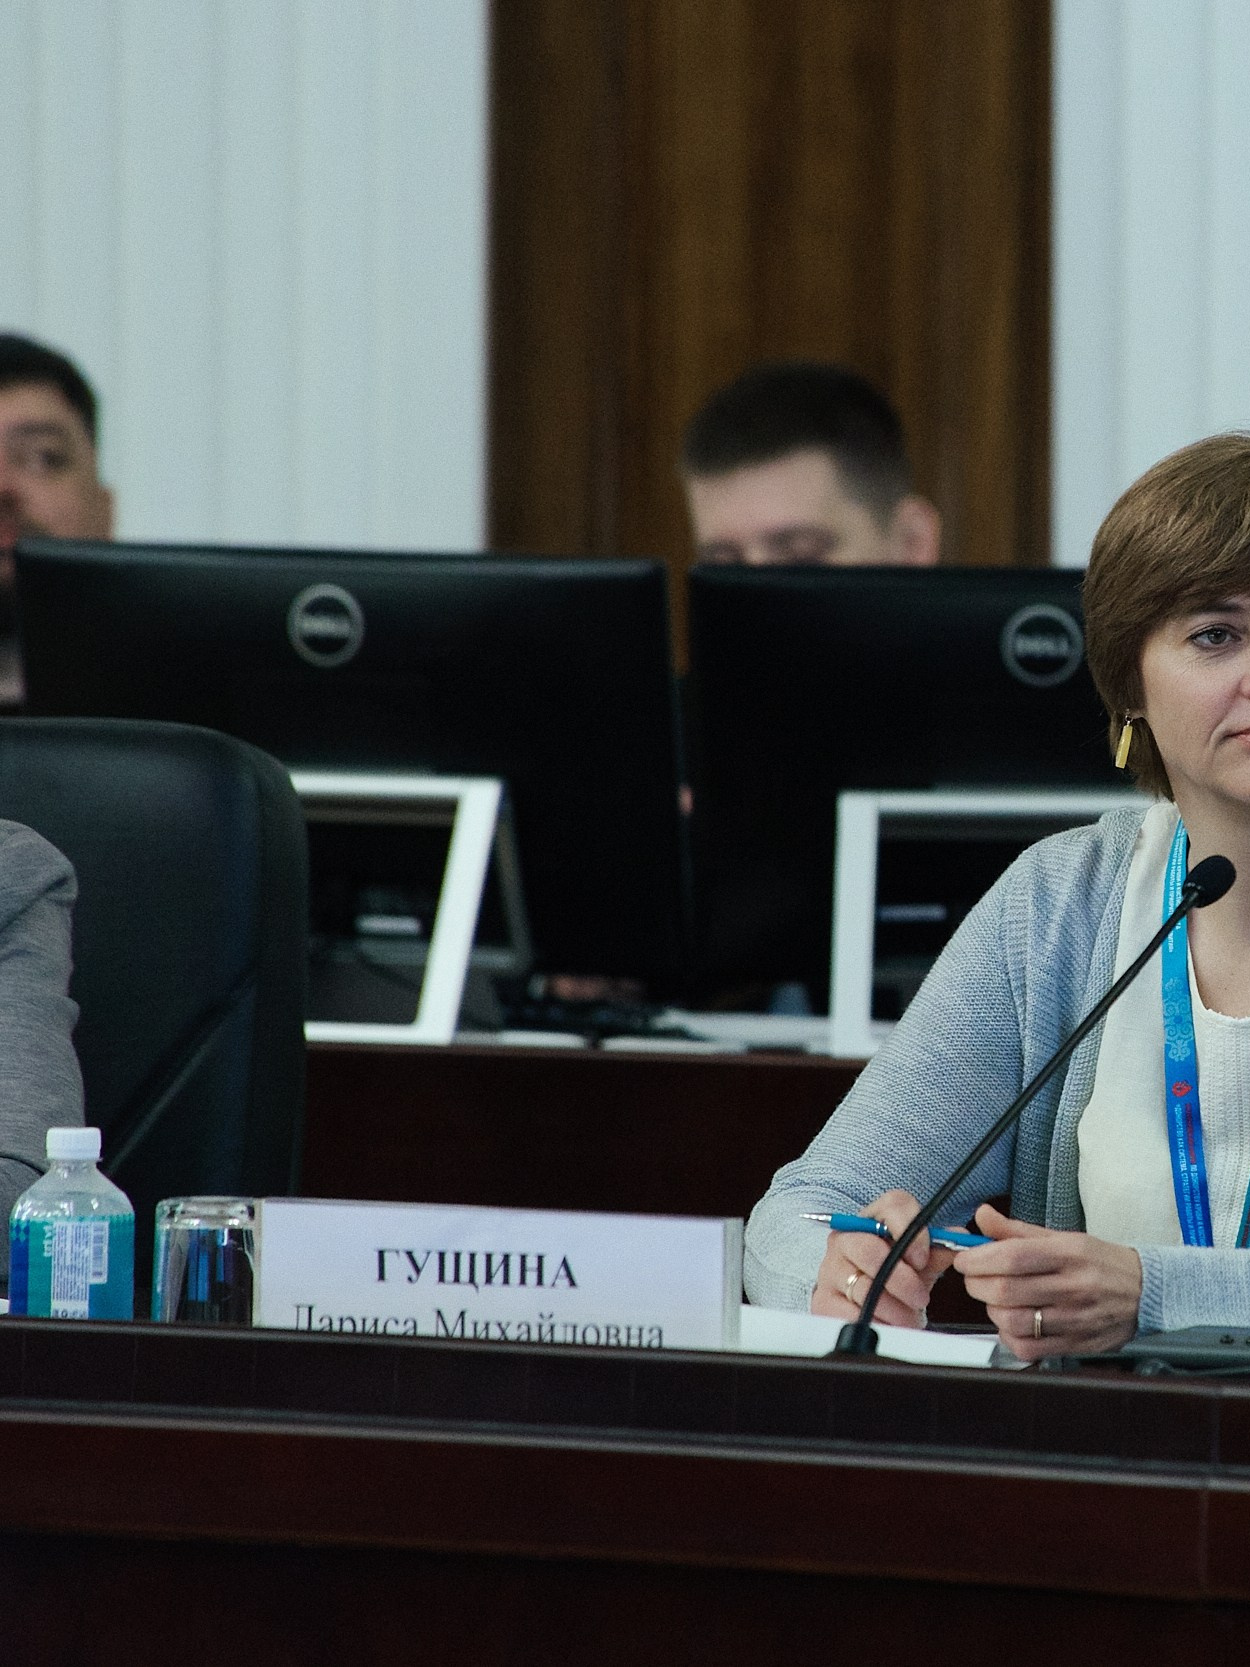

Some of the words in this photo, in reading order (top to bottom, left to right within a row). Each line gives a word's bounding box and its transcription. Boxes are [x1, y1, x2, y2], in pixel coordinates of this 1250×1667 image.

[374, 1248, 578, 1293] ГУЩИНА
[294, 1303, 418, 1337] Лариса
[435, 1308, 664, 1349] Михайловна
